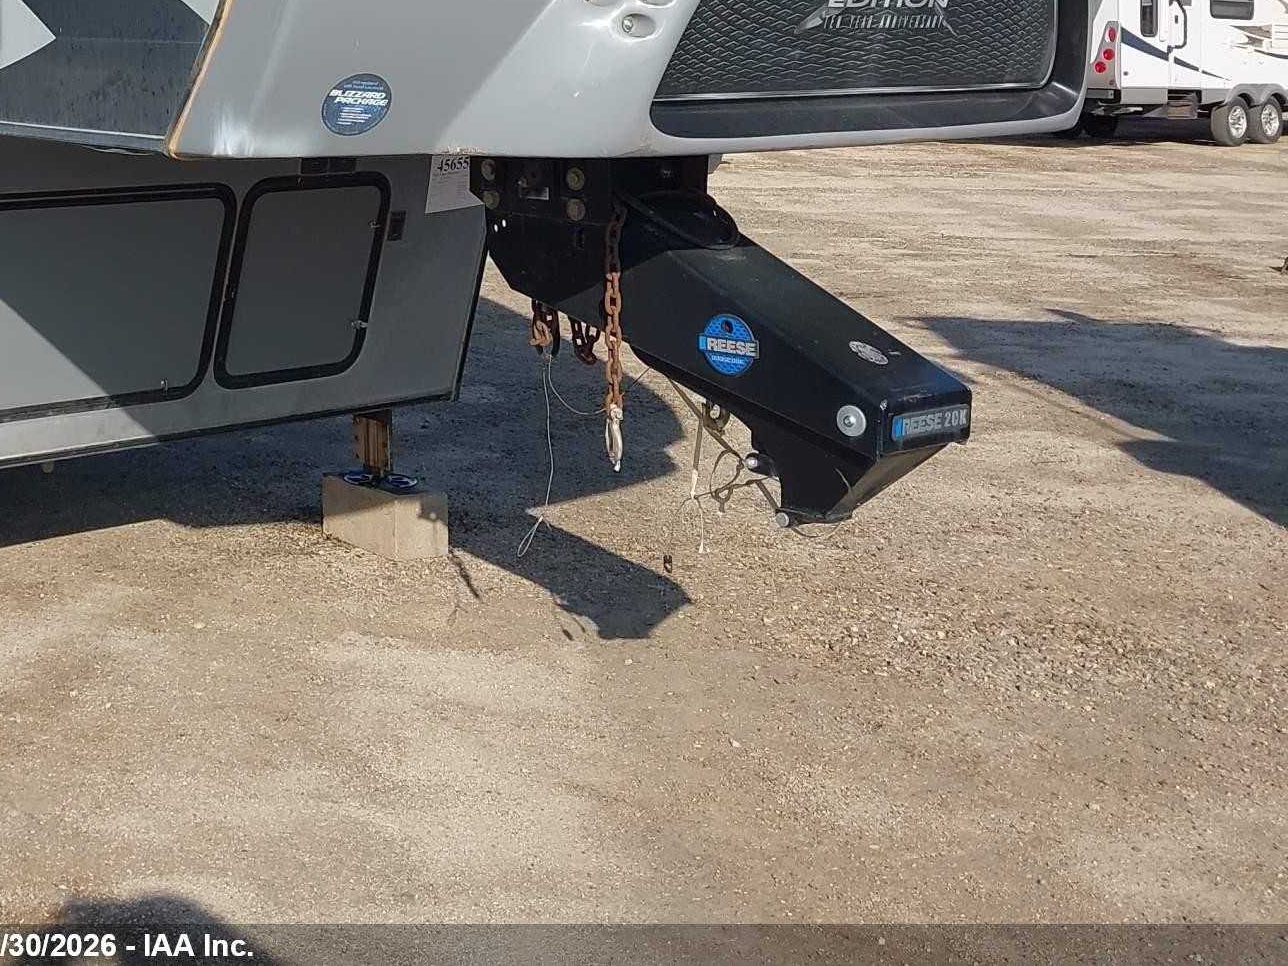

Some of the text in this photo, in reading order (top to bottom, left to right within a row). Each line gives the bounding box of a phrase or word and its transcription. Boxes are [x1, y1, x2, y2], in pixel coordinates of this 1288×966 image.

[329, 89, 386, 99] BLIZZARD
[334, 97, 388, 106] PACKAGE
[437, 156, 469, 172] 45655
[707, 337, 757, 357] REESE
[903, 409, 968, 435] REESE 20K
